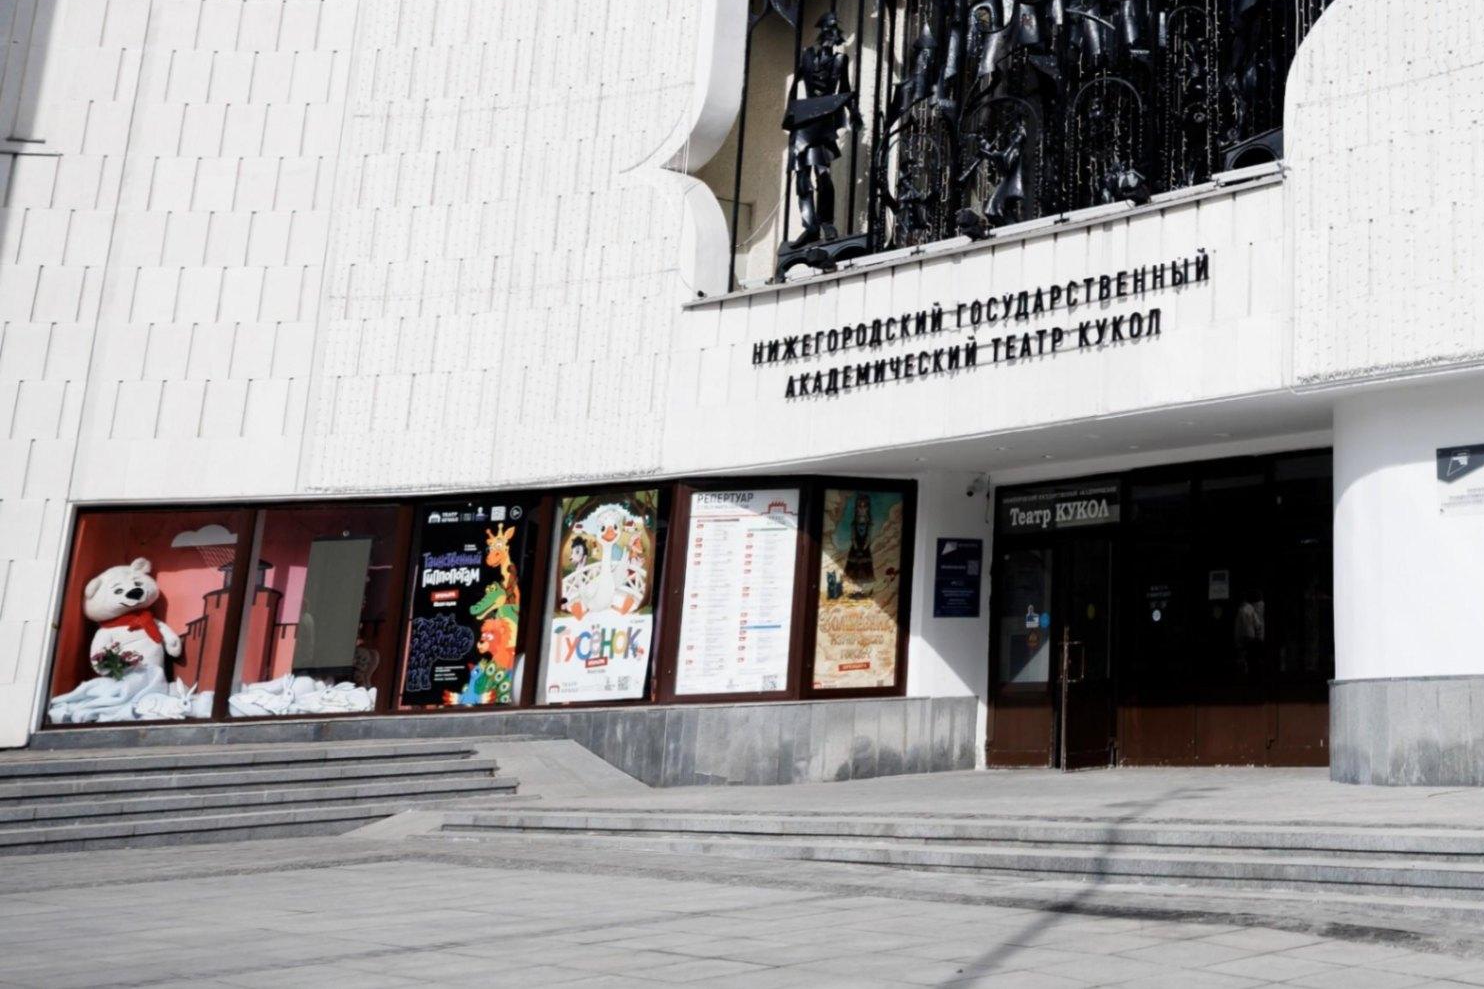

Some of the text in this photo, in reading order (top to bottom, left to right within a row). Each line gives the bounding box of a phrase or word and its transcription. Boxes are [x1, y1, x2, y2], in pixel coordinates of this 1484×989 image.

[752, 248, 1210, 366] НИЖЕГОРОДСКИЙ ГОСУДАРСТВЕННЫЙ
[785, 308, 1162, 398] АКАДЕМИЧЕСКИЙ ТЕАТР КУКОЛ
[697, 492, 754, 505] РЕПЕРТУАР
[1010, 498, 1109, 528] Театр КУКОЛ
